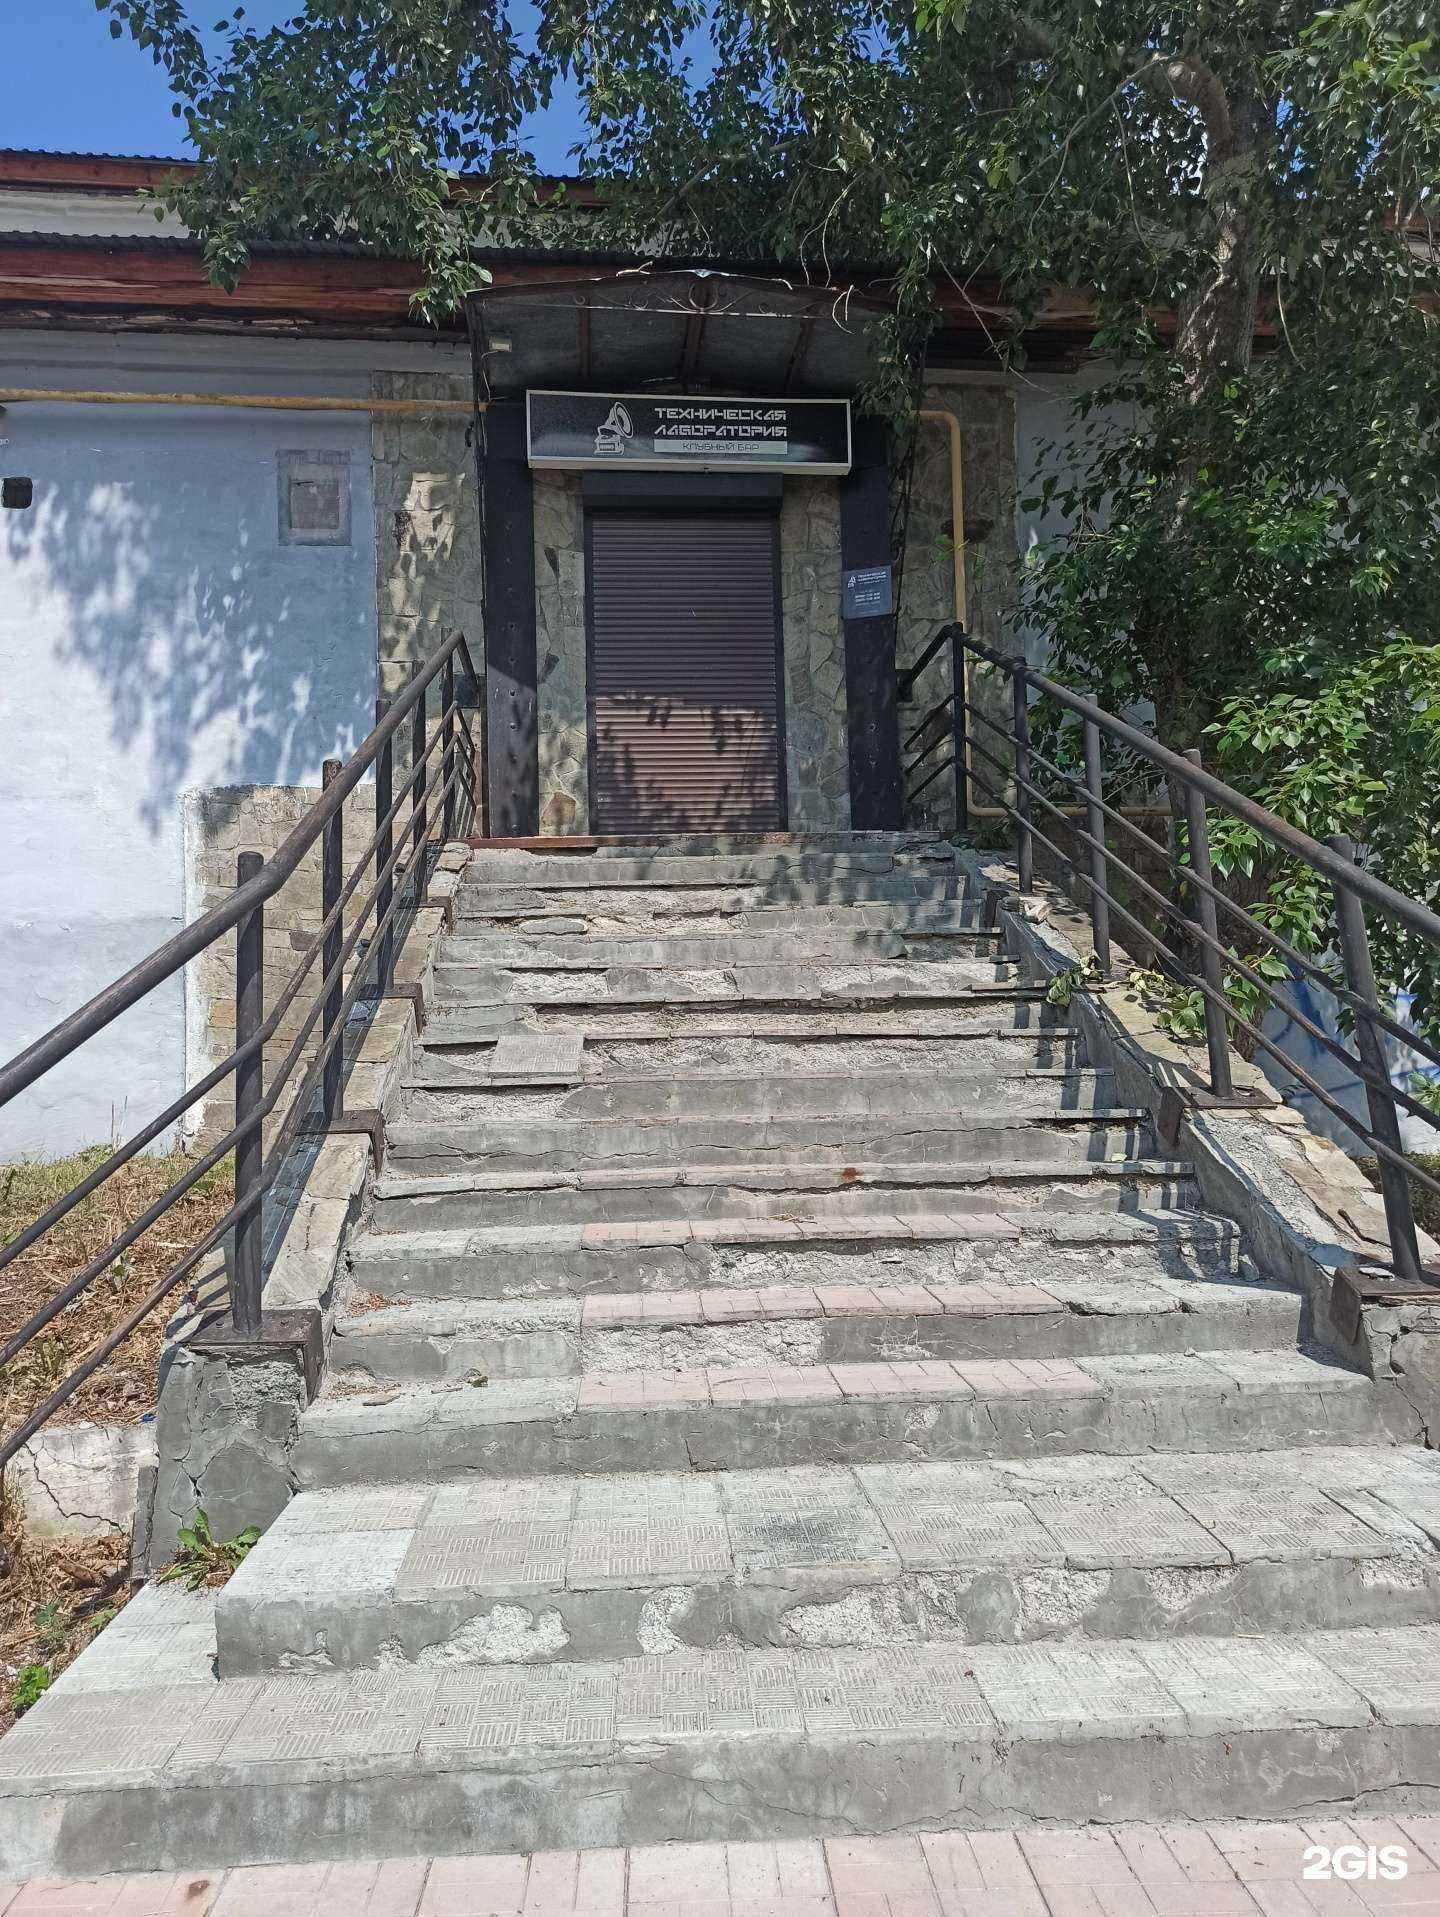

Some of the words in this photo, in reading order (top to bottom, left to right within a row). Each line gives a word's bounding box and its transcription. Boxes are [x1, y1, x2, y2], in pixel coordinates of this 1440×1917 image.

[654, 407, 787, 421] ТЕХНИЧЕСКАЯ
[654, 425, 787, 437] ЛАБОРАТОРИЯ
[682, 441, 735, 451] КЛУБНЫЙ
[737, 441, 760, 451] БАР
